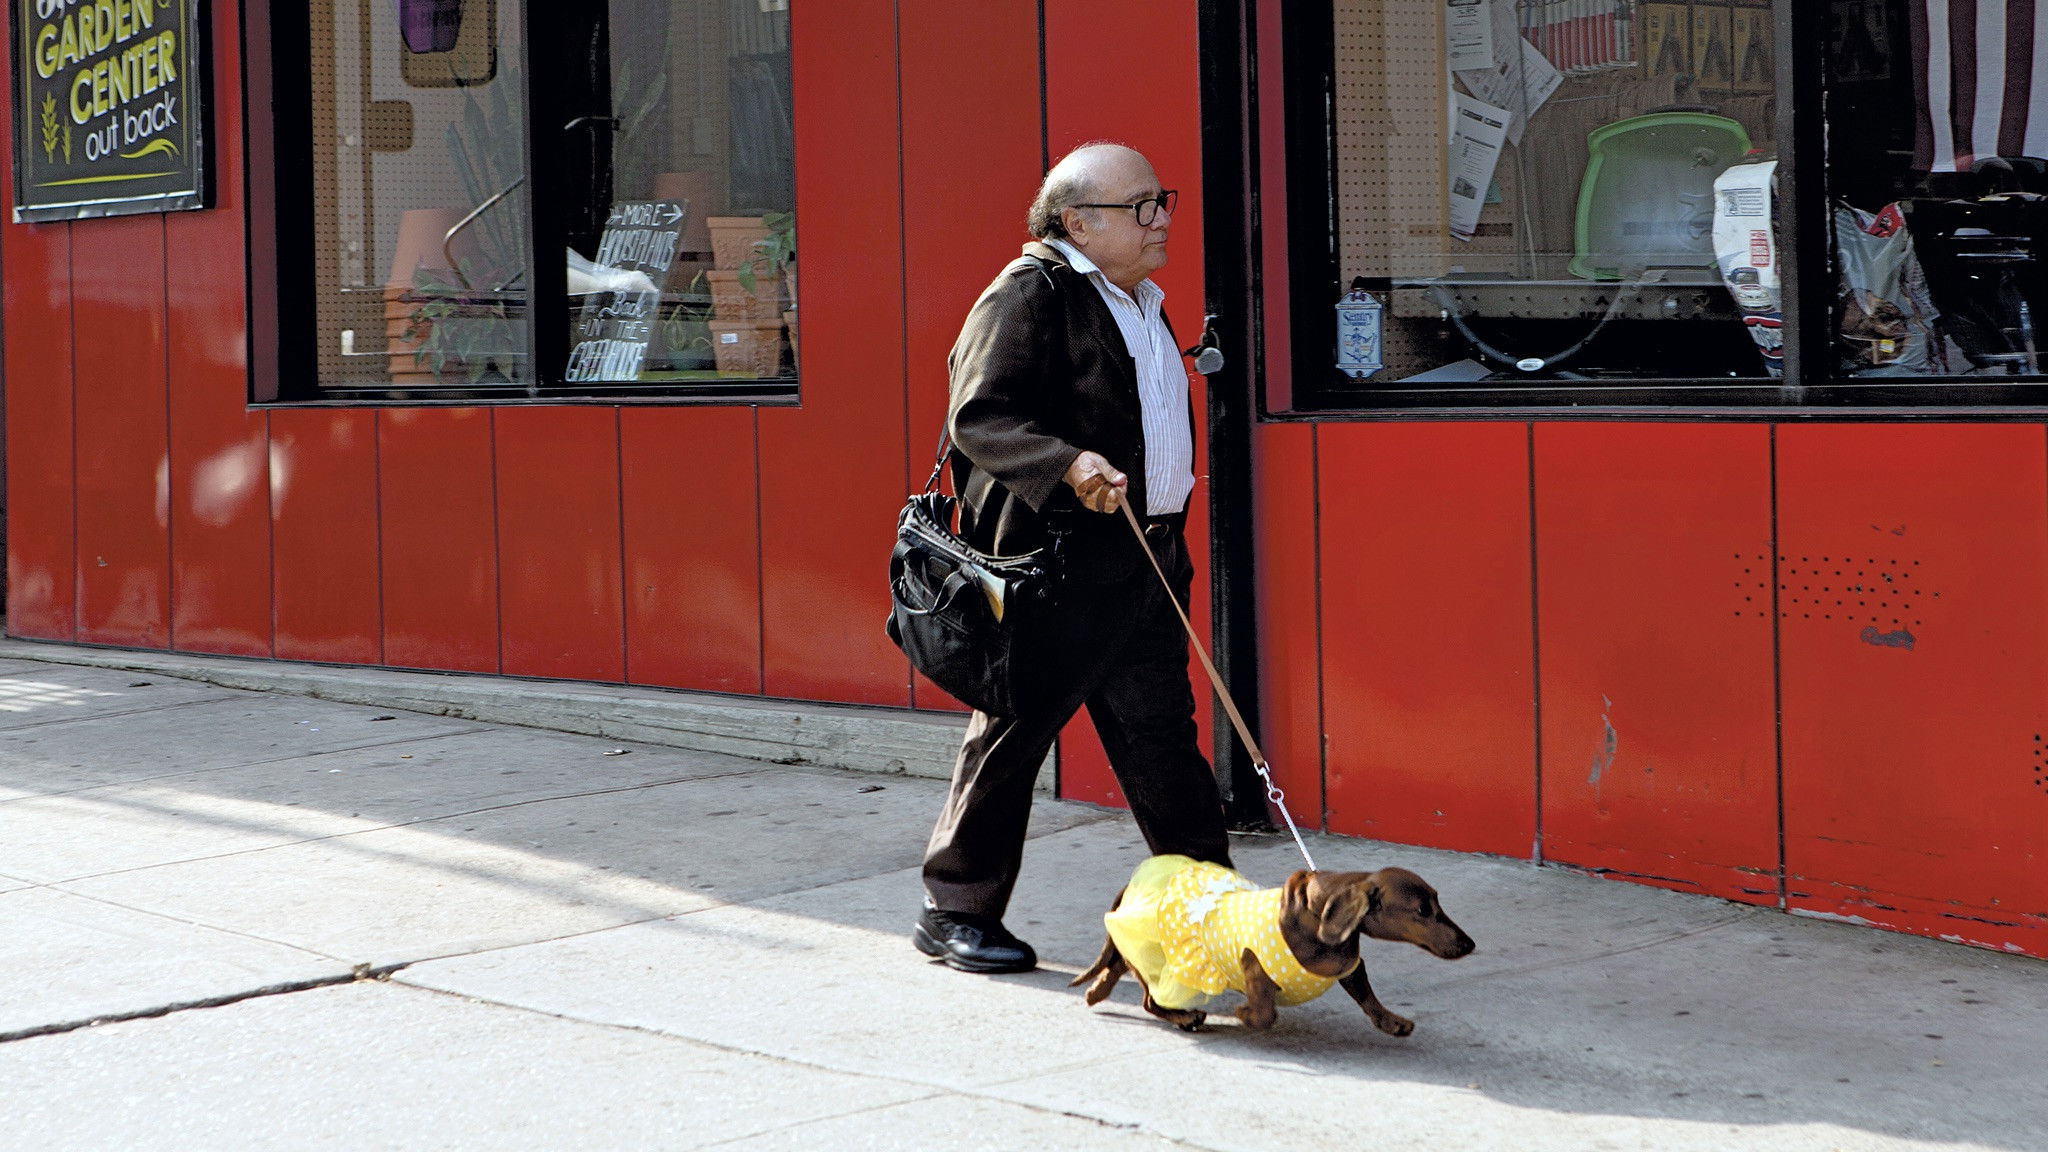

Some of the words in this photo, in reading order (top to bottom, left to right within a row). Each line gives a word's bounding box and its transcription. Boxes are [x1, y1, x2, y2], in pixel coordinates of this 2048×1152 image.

[35, 0, 153, 78] GARDEN
[70, 30, 177, 125] CENTER
[85, 115, 119, 161] out
[124, 91, 177, 145] back
[621, 204, 667, 226] MORE
[584, 319, 605, 337] IN
[616, 321, 644, 340] THE
